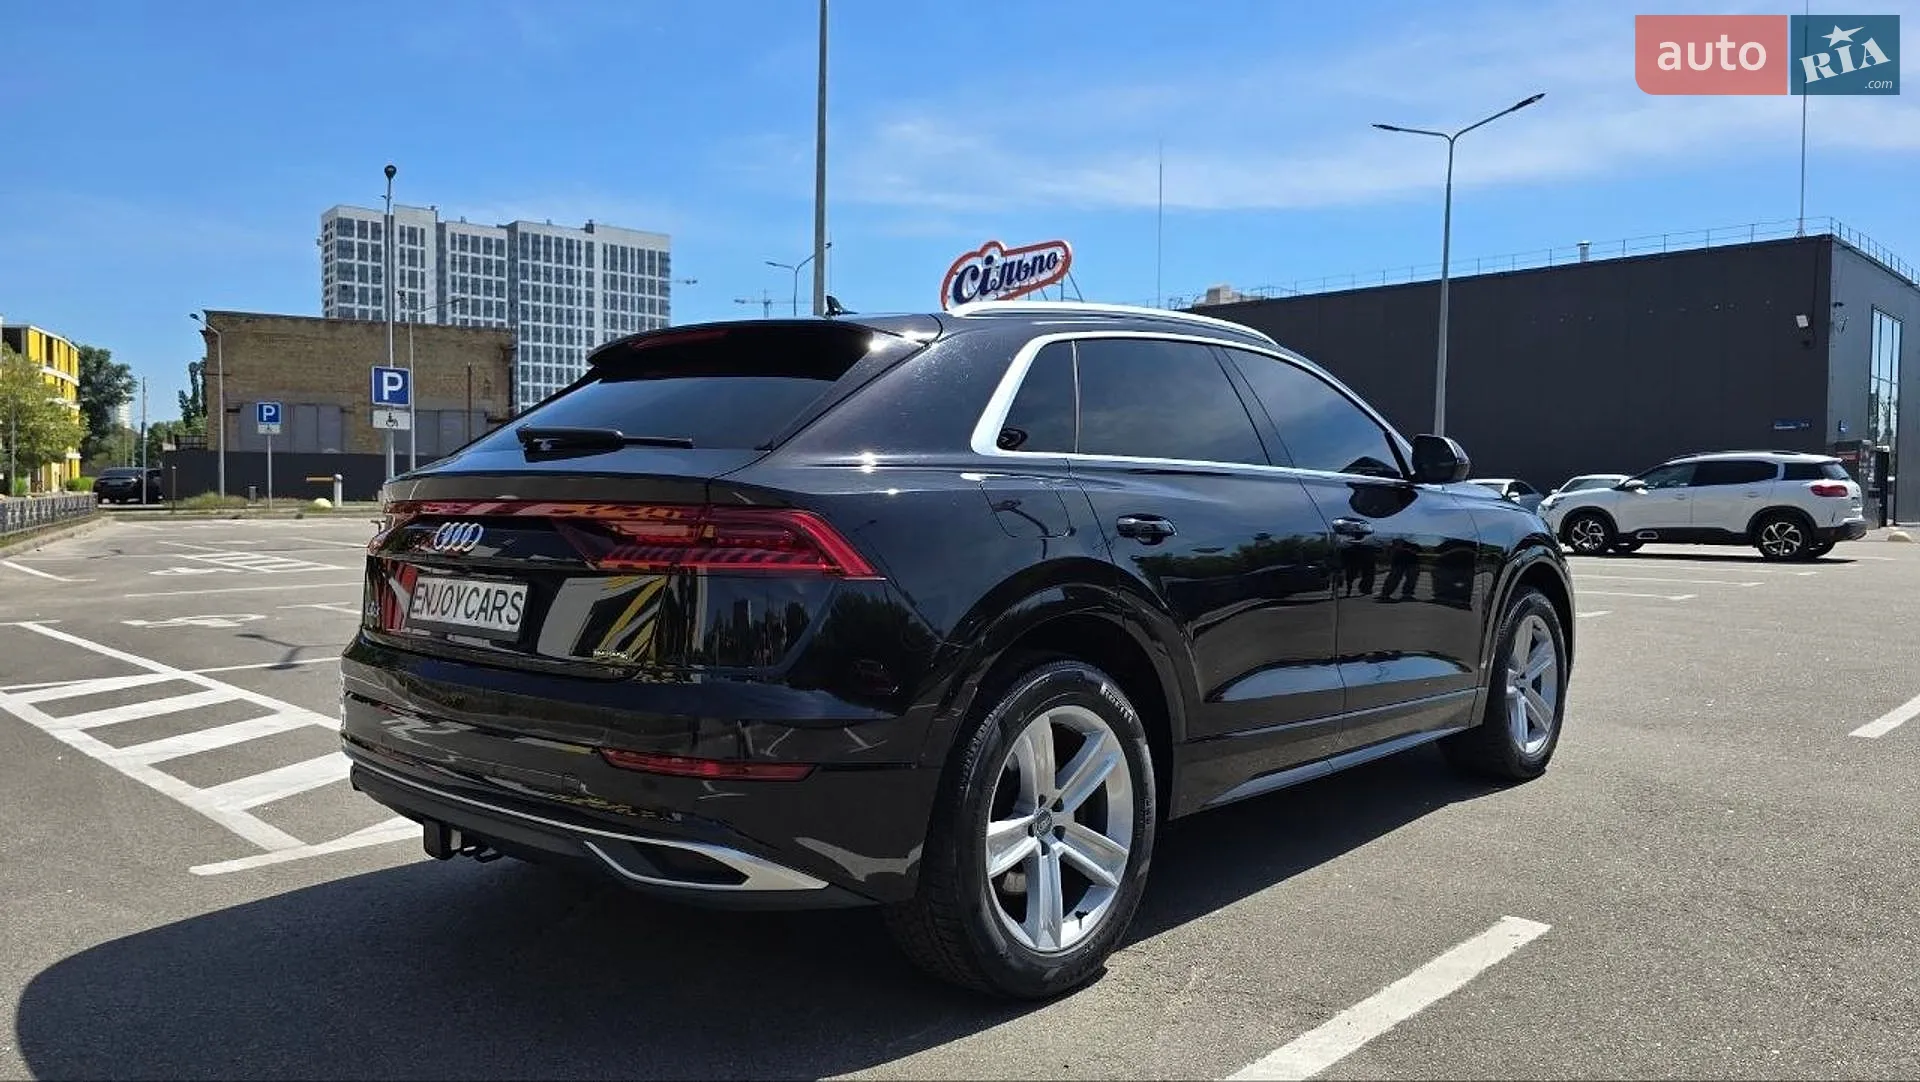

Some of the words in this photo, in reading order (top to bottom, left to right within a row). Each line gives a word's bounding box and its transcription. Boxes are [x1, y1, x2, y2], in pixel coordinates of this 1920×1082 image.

[953, 250, 1059, 304] Сільпо
[382, 371, 404, 401] P
[263, 405, 277, 422] P
[411, 582, 523, 625] ENJOYCARS
